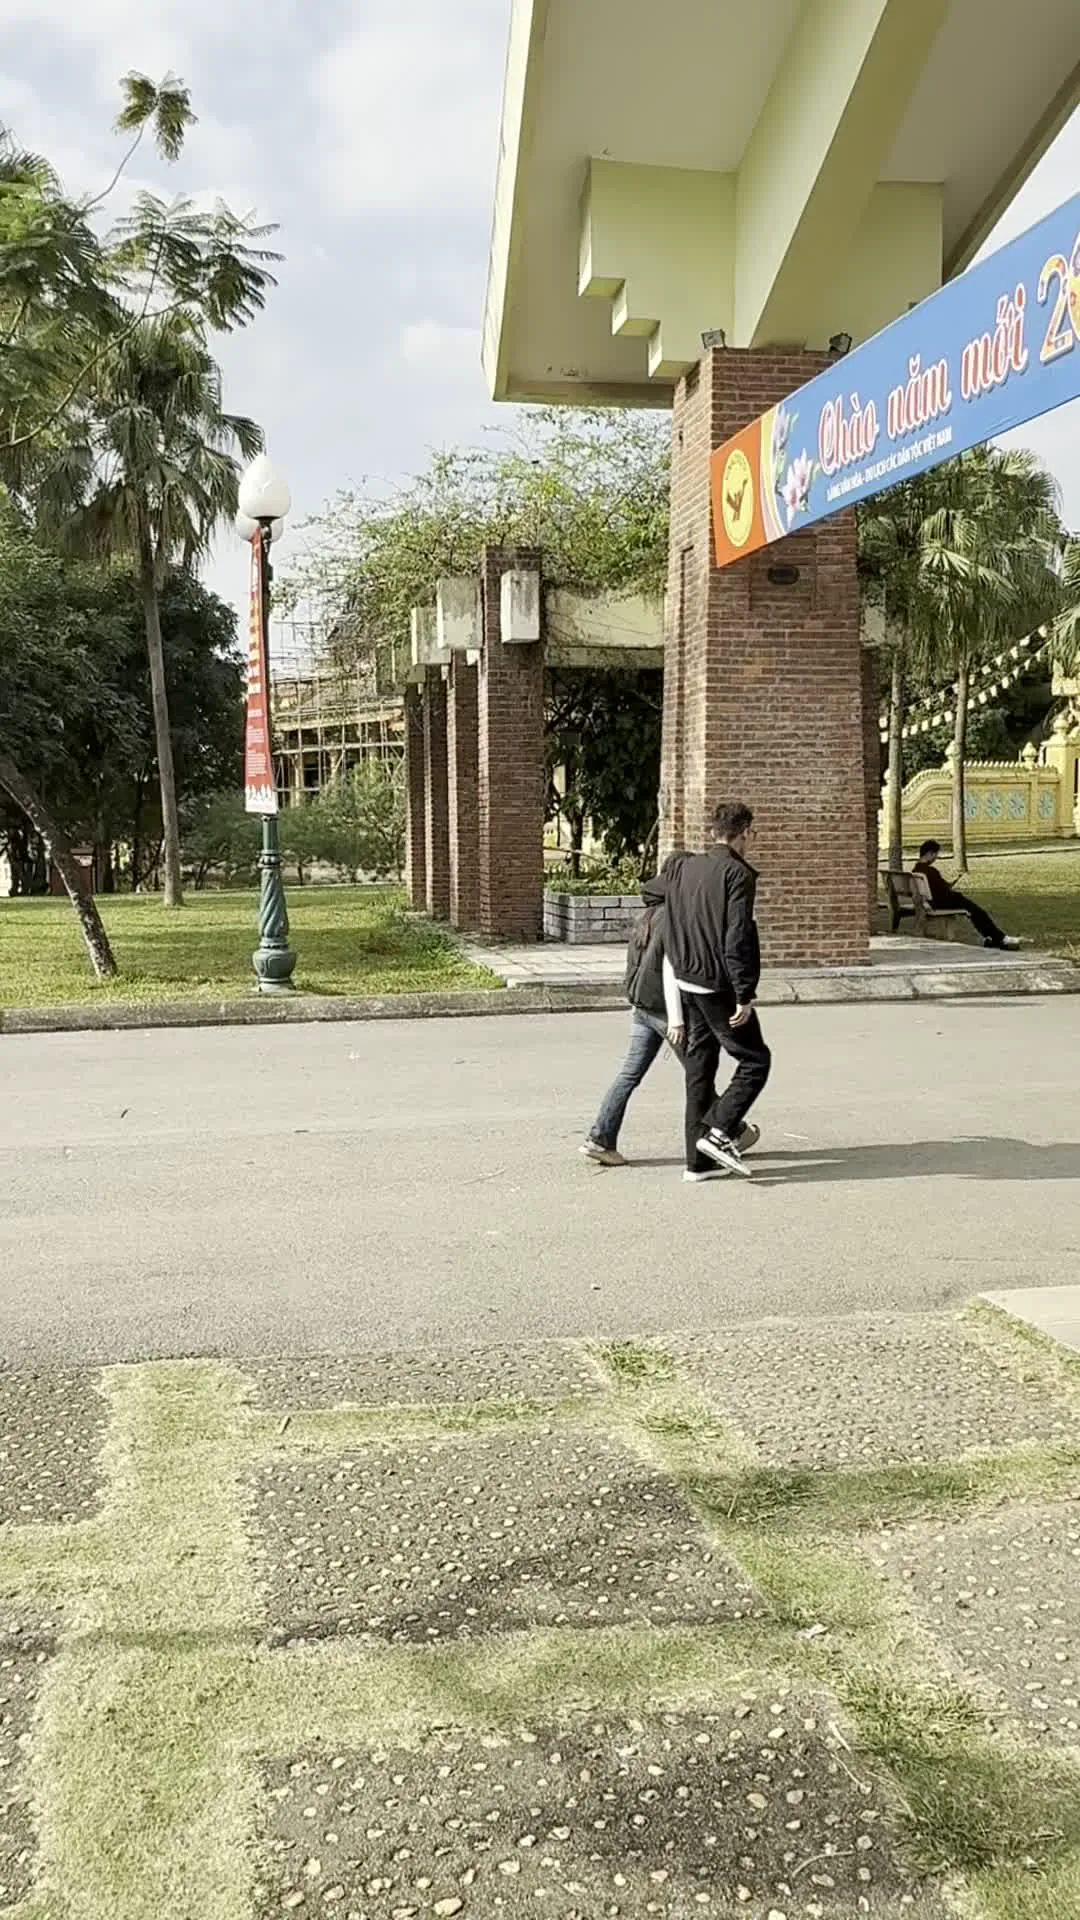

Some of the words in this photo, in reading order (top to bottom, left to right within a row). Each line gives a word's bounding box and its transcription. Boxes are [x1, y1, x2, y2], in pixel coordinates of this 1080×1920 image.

[818, 391, 880, 476] Chào
[887, 354, 952, 440] năm
[961, 283, 1028, 400] mới
[937, 425, 952, 448] NAM
